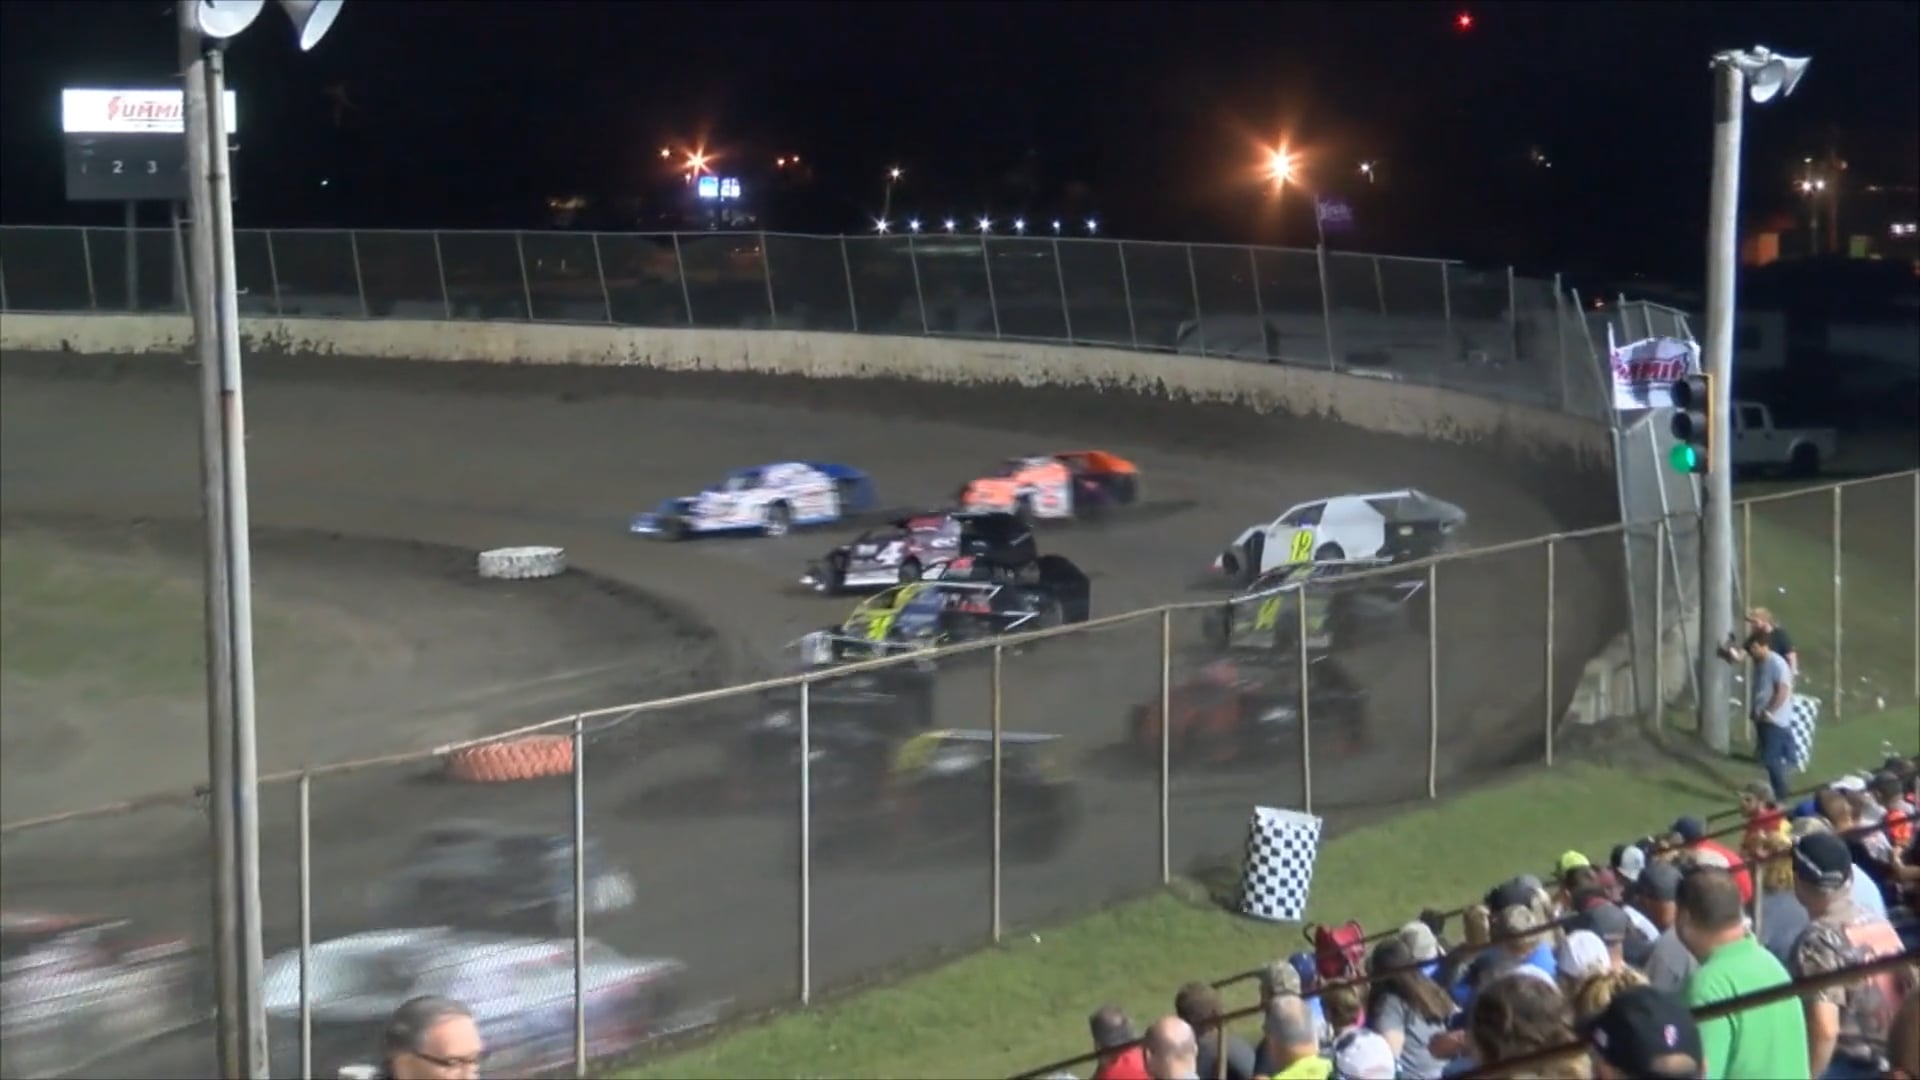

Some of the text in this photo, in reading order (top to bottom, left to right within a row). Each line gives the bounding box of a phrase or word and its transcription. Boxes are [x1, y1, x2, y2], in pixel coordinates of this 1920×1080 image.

[107, 96, 184, 121] SUMMI
[112, 160, 124, 174] 2
[147, 160, 158, 174] 3
